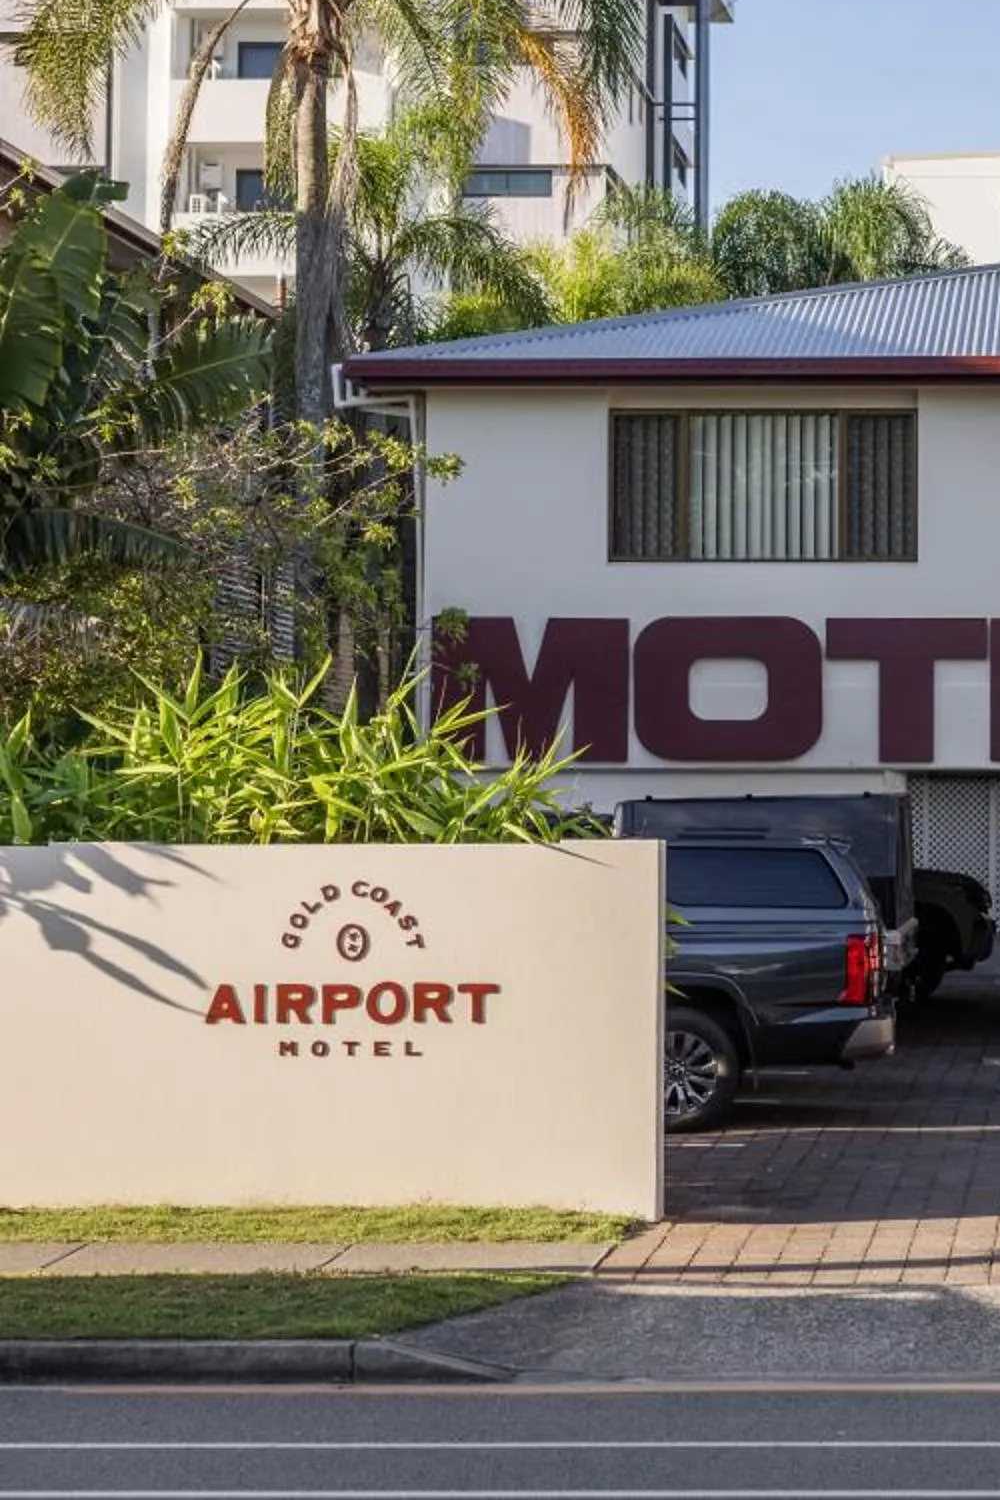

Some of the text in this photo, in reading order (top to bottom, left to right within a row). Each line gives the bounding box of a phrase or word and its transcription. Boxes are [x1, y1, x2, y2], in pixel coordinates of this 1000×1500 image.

[281, 880, 426, 950] GOLD COAST
[205, 981, 501, 1025] AIRPORT
[279, 1040, 423, 1057] MOTEL
